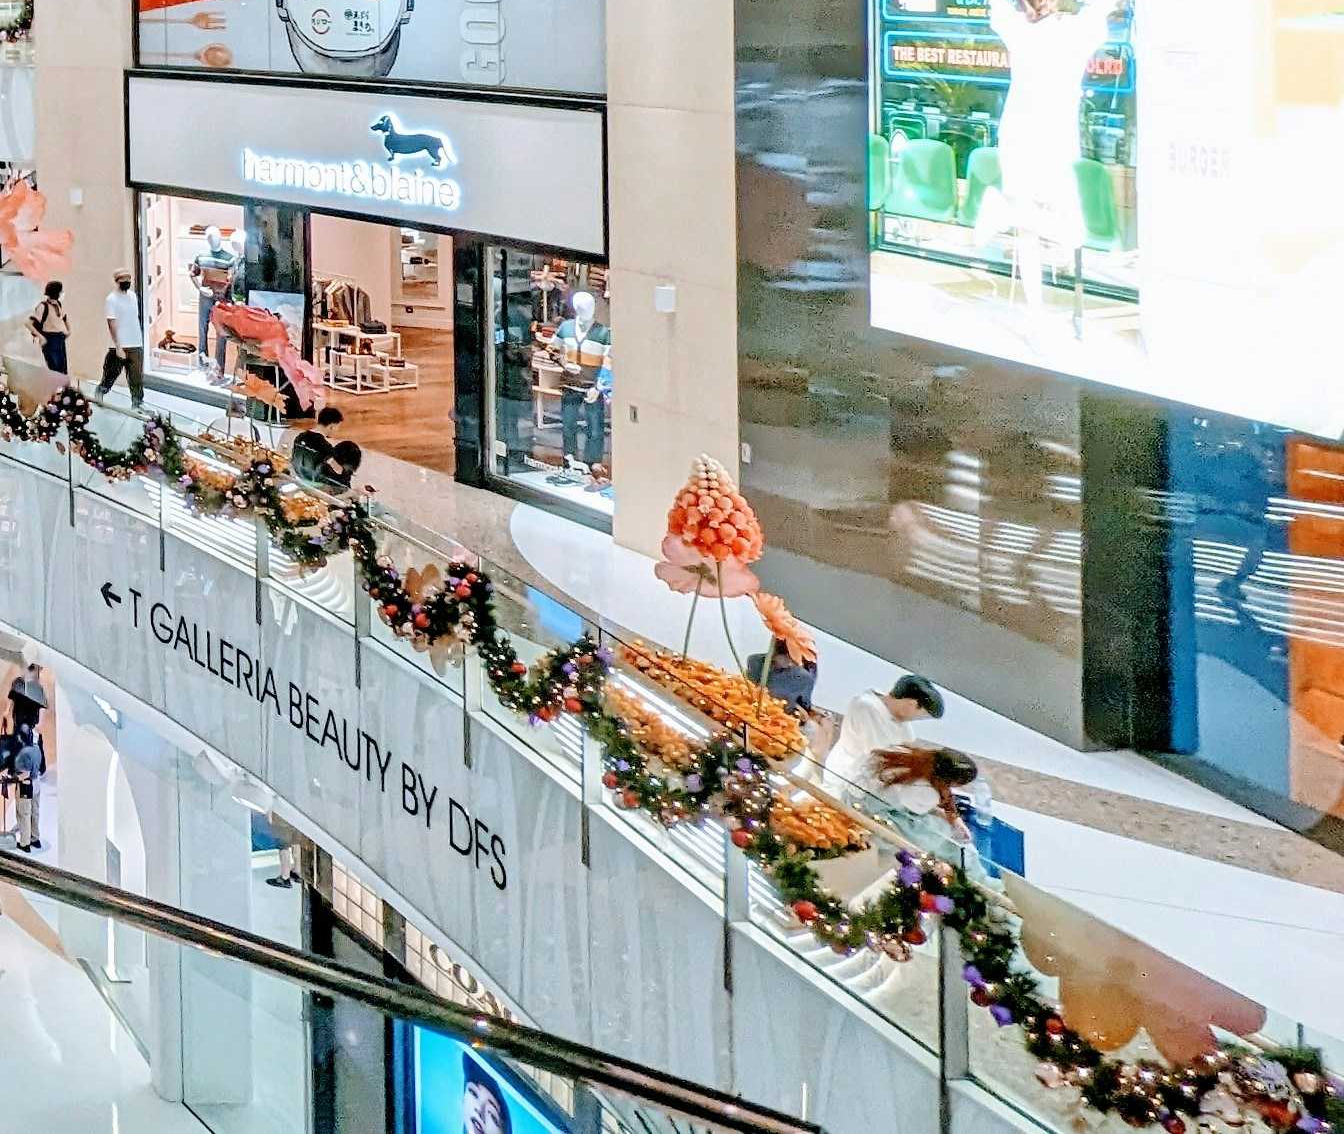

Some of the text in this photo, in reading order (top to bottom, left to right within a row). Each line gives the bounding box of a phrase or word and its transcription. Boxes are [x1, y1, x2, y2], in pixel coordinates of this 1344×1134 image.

[893, 45, 1010, 68] THE BEST RESTAURA
[128, 587, 508, 891] T GALLERIA BEAUTY BY DFS
